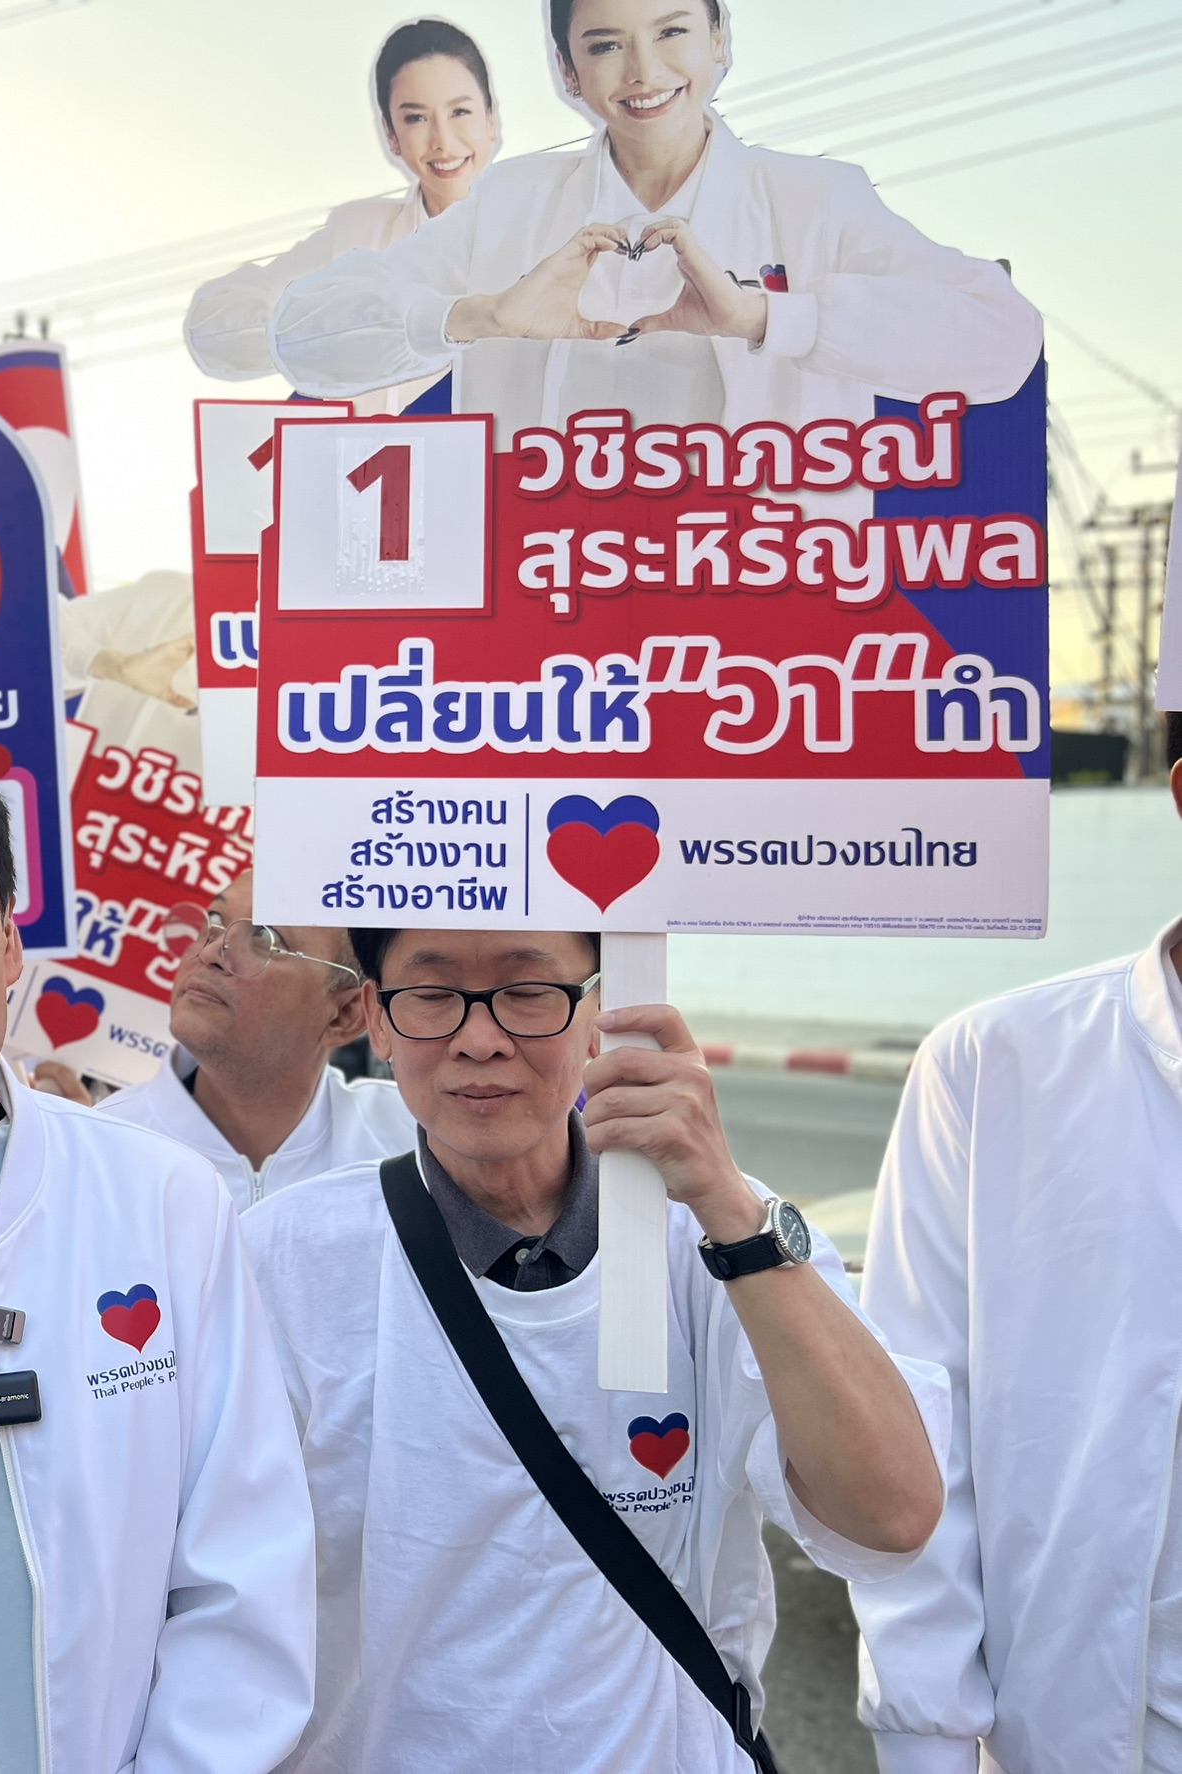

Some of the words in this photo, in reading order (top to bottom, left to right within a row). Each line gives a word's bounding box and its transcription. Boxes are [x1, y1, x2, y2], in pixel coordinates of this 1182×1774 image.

[519, 399, 958, 491] วชิราภรณ์
[346, 445, 412, 561] 1
[518, 505, 1037, 614] สุระหิรัญพล
[371, 790, 507, 825] สร้างคน
[350, 833, 507, 868] สร้างงาน
[679, 827, 977, 867] พรรคปวงชนไทย
[321, 875, 508, 911] สร้างอาชีพ
[92, 1385, 117, 1399] Thai
[121, 1373, 165, 1392] People's
